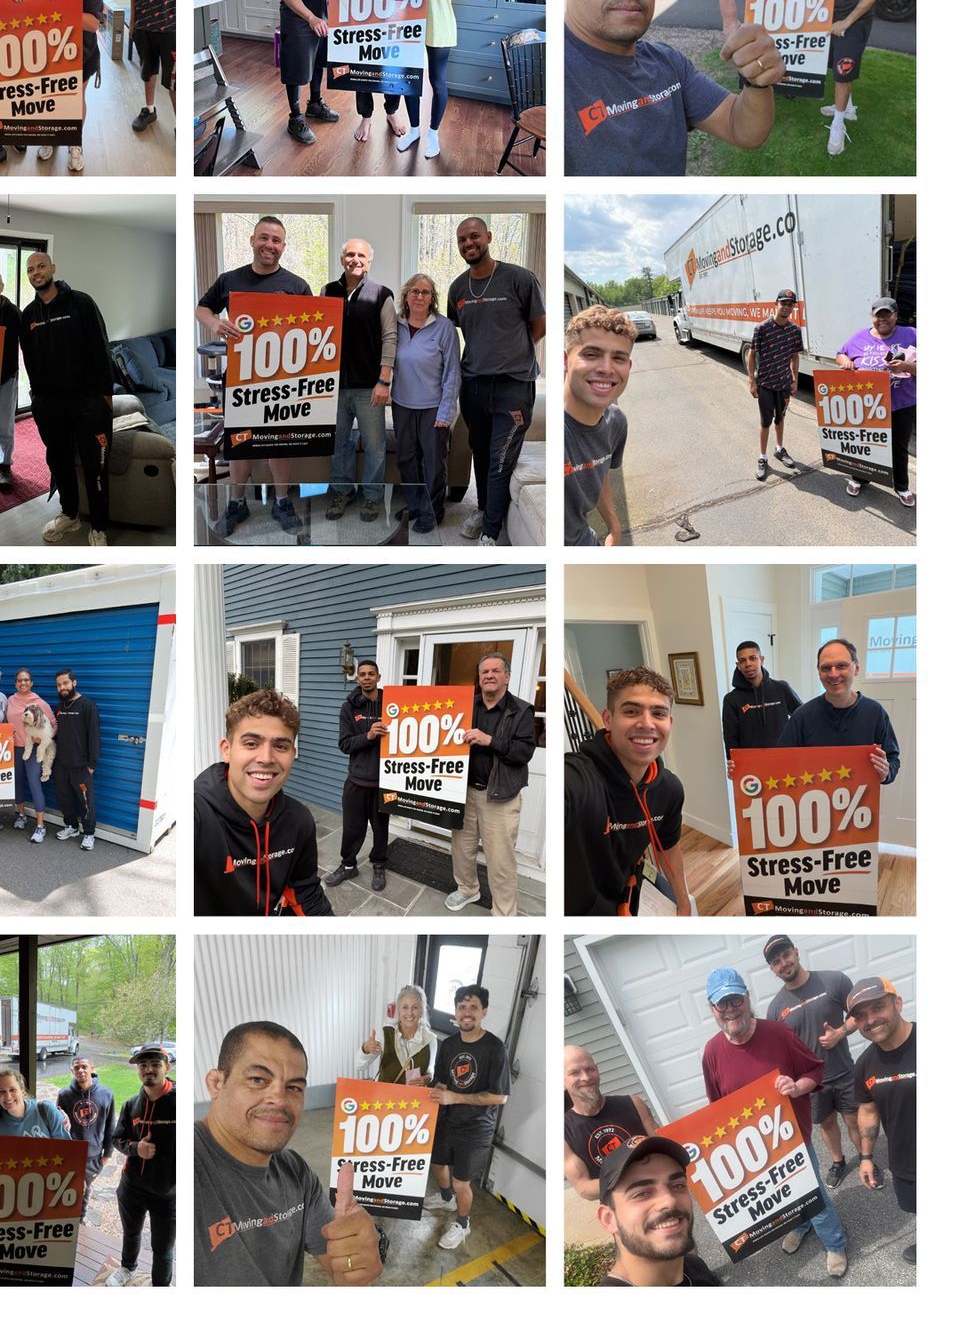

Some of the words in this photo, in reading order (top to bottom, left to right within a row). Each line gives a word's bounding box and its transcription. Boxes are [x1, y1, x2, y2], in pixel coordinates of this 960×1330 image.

[333, 24, 422, 45] Stress-Free
[359, 46, 399, 61] Move
[350, 69, 419, 80] MovingandStorage.com
[11, 97, 55, 117] Move
[4, 124, 77, 132] MovingandStorage.com
[234, 326, 336, 380] 100%
[232, 377, 335, 407] Stress-Free
[263, 402, 311, 423] Move
[819, 393, 886, 425] 100%
[252, 431, 331, 440] MovingandStorage.com
[822, 428, 887, 442] Stress-Free
[840, 441, 871, 456] Move
[386, 713, 465, 754] 100%
[384, 759, 464, 774] Stress-Free
[405, 777, 442, 791] Move
[742, 784, 871, 850] 100%
[747, 850, 871, 877] Stress-Free
[785, 876, 840, 897] Move
[340, 1114, 429, 1153] 100%
[691, 1104, 793, 1203] 100%
[362, 1175, 402, 1189] Move
[713, 1150, 805, 1224] Stress-Free
[748, 1183, 791, 1221] Move
[0, 1242, 47, 1259] Move
